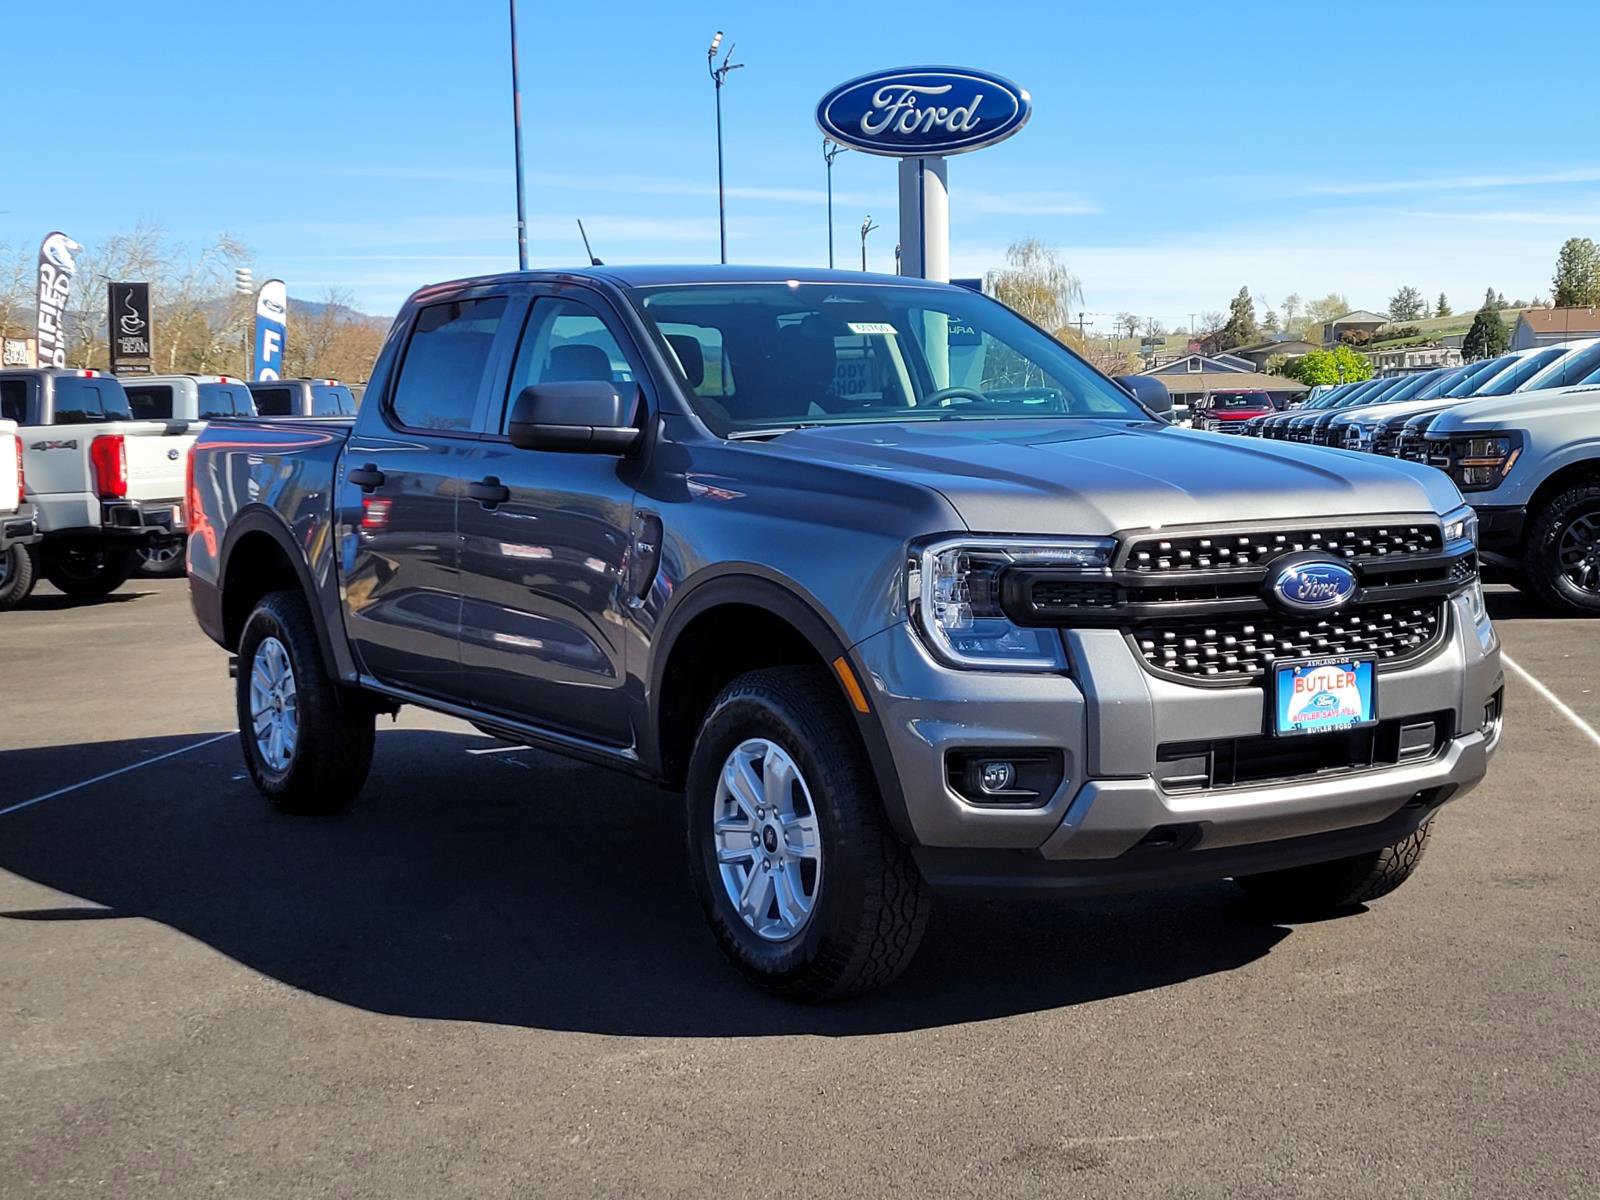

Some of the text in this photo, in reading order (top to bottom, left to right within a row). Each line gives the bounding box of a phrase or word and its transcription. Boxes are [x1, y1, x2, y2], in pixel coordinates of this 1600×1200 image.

[860, 84, 983, 135] Ford
[949, 326, 975, 335] URA
[122, 342, 149, 353] BEAN
[834, 363, 866, 378] ODY
[1298, 573, 1340, 599] Ford
[1307, 659, 1336, 667] ASHLAND
[1295, 672, 1356, 693] BUTLER
[1292, 711, 1321, 722] BUTLER
[1307, 722, 1352, 734] BUTLER FORD
